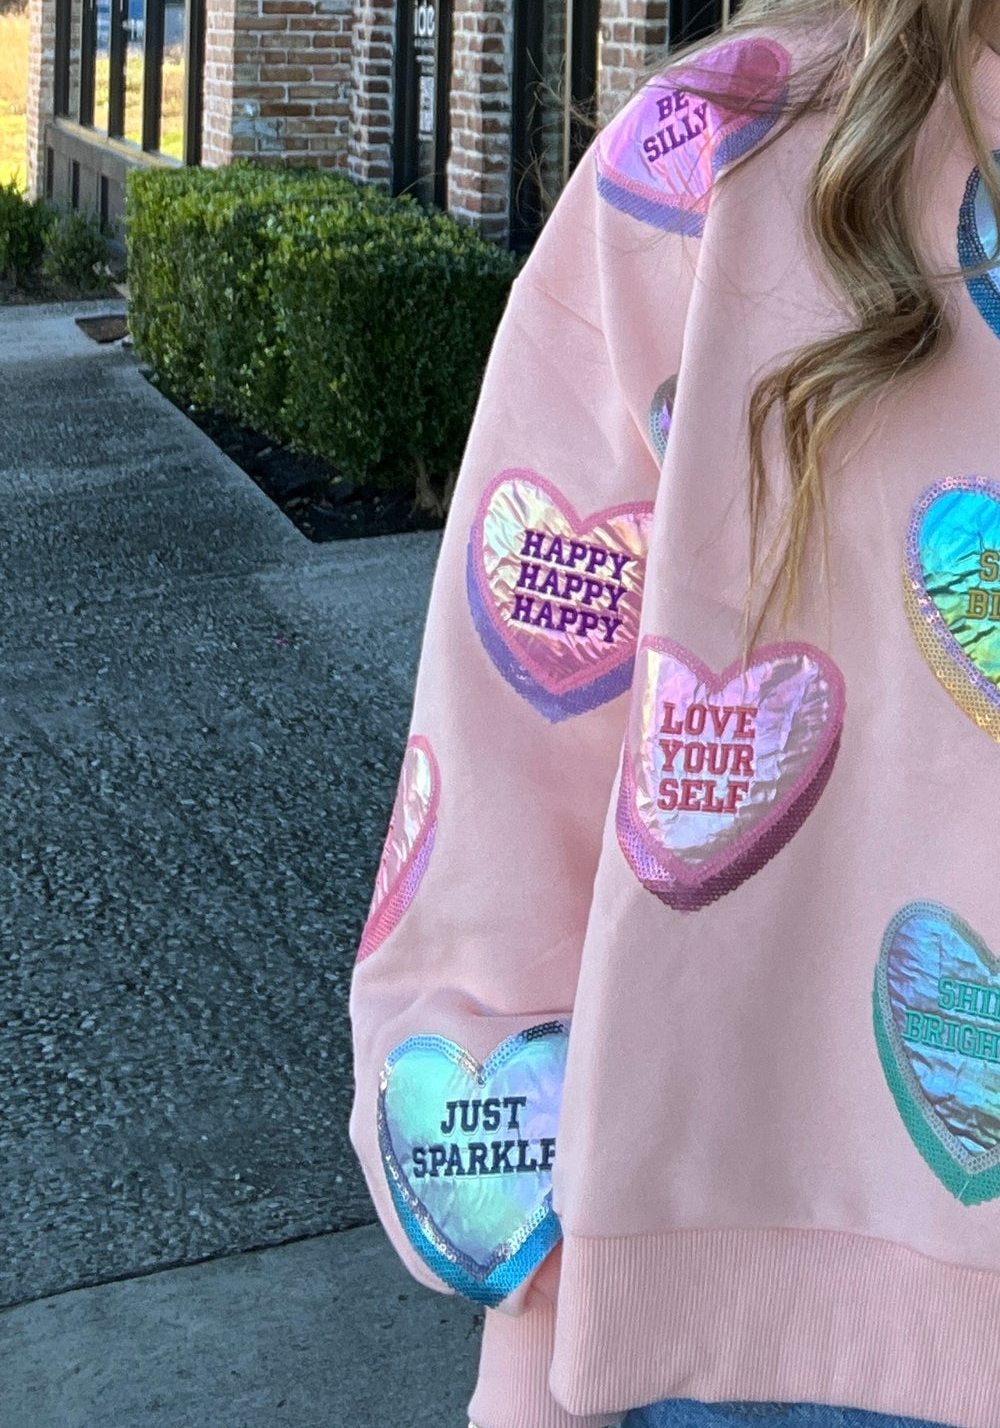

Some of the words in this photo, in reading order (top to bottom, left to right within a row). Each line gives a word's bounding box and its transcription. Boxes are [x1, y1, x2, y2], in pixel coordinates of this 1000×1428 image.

[656, 89, 690, 122] BE
[643, 101, 708, 163] SILLY
[519, 530, 632, 581] HAPPY
[515, 561, 628, 612] HAPPY
[510, 593, 624, 643] HAPPY
[659, 701, 759, 740] LOVE
[658, 738, 756, 777] YOUR
[656, 777, 751, 814] SELF
[440, 1096, 528, 1135] JUST
[411, 1137, 557, 1179] SPARKLE
